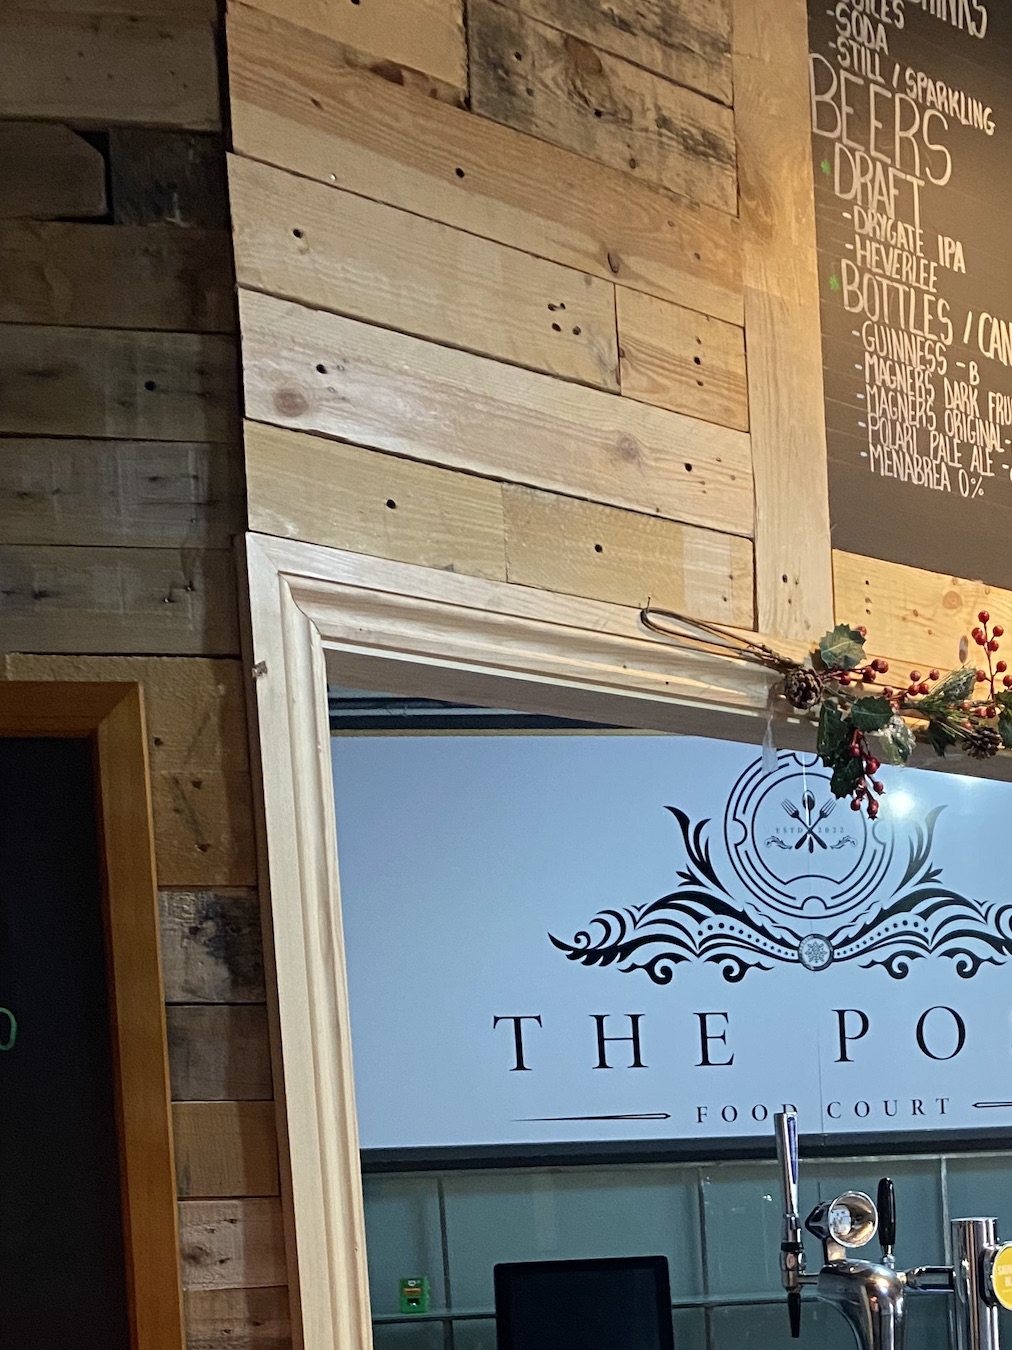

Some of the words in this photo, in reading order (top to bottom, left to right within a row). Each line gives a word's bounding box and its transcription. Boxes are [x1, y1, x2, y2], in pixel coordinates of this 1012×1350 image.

[835, 2, 889, 55] SODA
[836, 36, 884, 84] STILL
[904, 66, 996, 136] SPARKLING
[808, 52, 952, 186] BEERS
[834, 141, 925, 226] DRAFT
[853, 204, 924, 257] DRYGATE
[937, 234, 966, 274] IPA
[855, 234, 938, 293] HEVERLEE
[841, 258, 953, 346] BOTTLES
[862, 320, 947, 375] GUINNESS
[865, 352, 935, 402] MAGNERS
[944, 377, 980, 417] DARK
[865, 384, 937, 431] MAGNERS
[868, 443, 951, 492] MENABREA
[958, 468, 984, 498] 0%
[929, 430, 962, 468] PALE
[970, 446, 995, 477] ALE
[493, 1010, 735, 1072] THE
[826, 1097, 951, 1119] COURT
